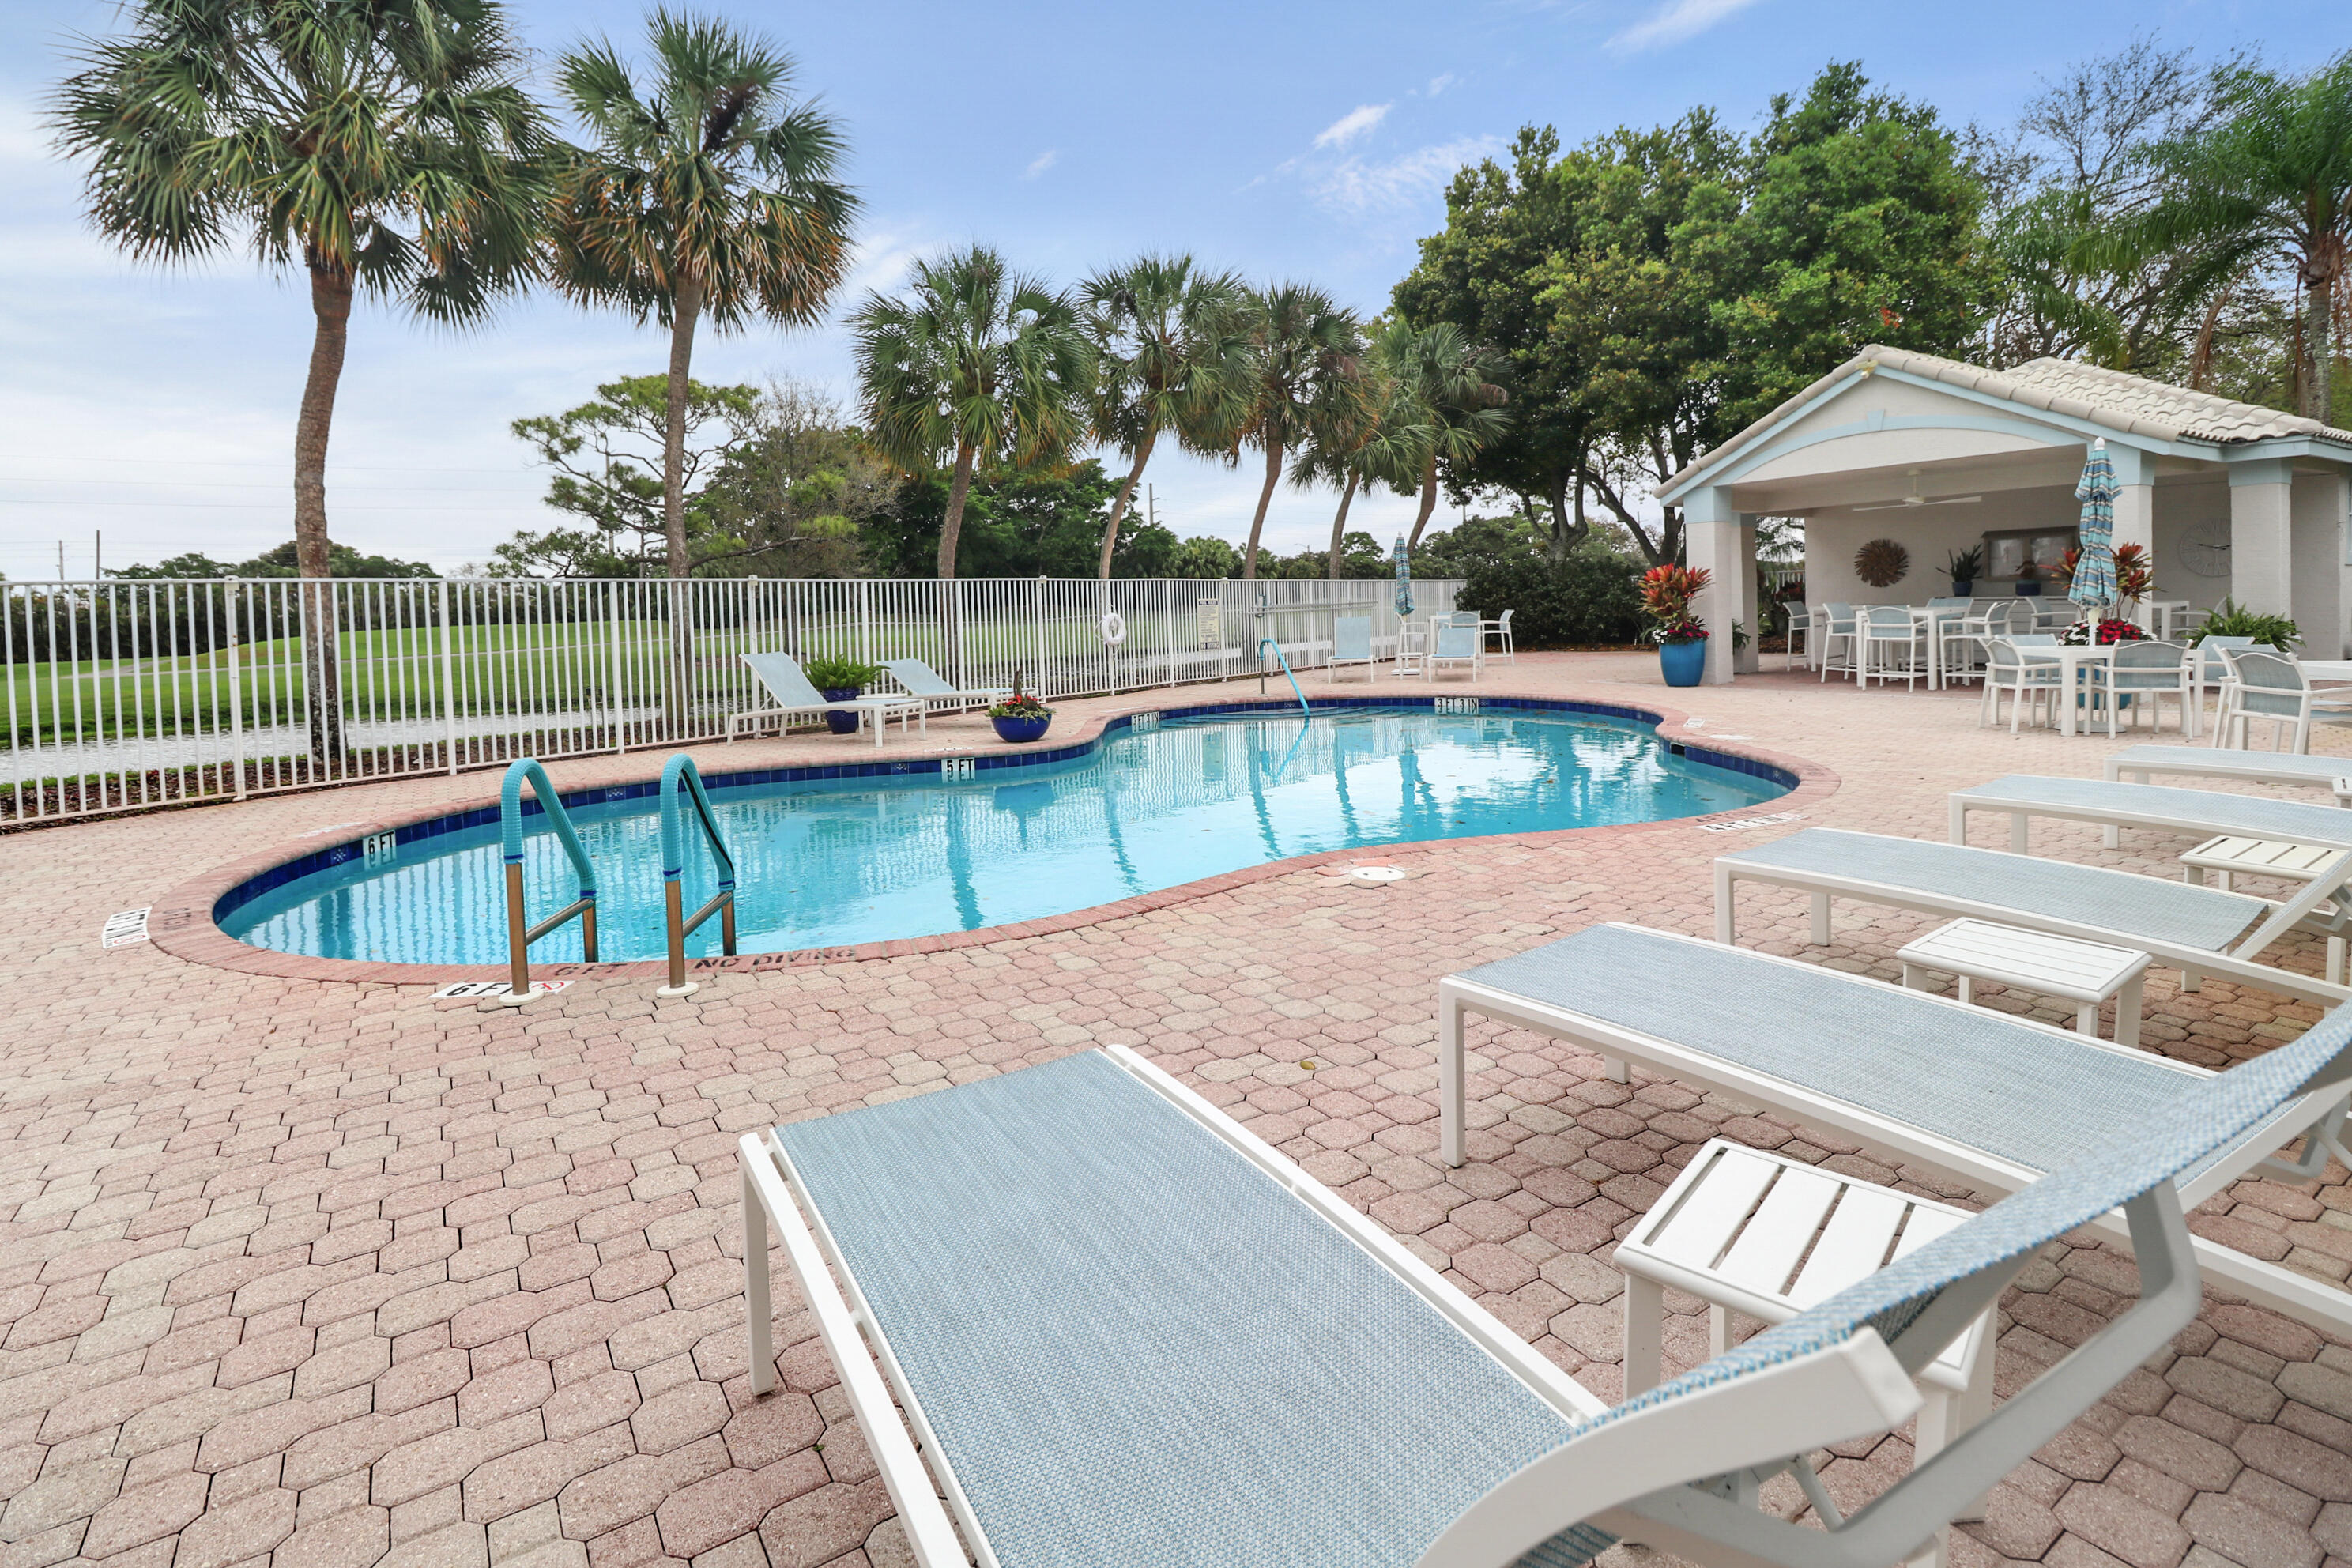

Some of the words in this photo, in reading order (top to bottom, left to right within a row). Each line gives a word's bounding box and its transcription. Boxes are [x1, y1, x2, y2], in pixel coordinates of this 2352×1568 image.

[1438, 698, 1443, 707] 3
[1446, 698, 1456, 707] FT
[1460, 698, 1464, 707] 3
[1468, 698, 1477, 707] IN
[947, 760, 953, 772] 5
[959, 759, 974, 772] FT
[368, 837, 375, 854] 6
[379, 831, 394, 850] FT
[695, 957, 740, 969] NO
[445, 983, 478, 997] 6
